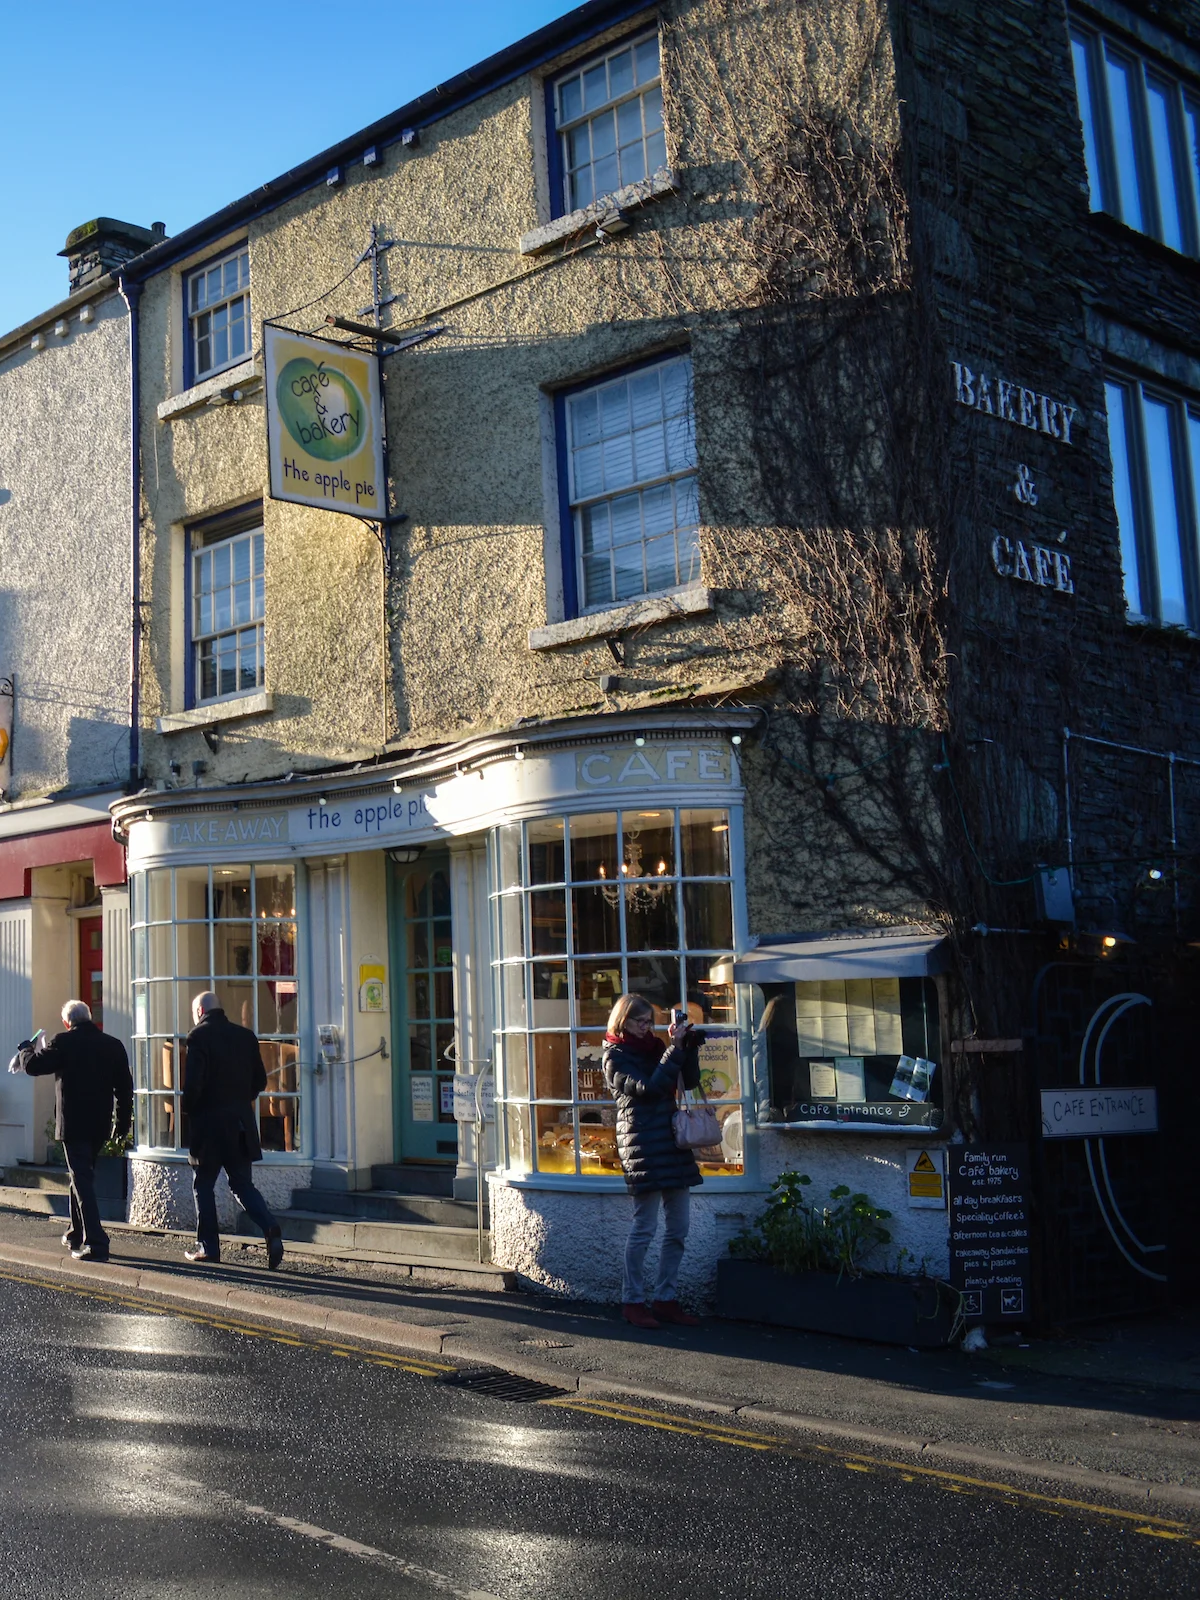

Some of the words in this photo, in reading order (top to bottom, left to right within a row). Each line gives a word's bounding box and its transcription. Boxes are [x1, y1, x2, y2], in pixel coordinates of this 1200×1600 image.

[291, 361, 330, 397] café
[313, 394, 329, 415] &
[951, 361, 1077, 445] BAKERY
[296, 410, 360, 445] bakery
[283, 457, 310, 482] the
[315, 470, 351, 498] apple
[355, 480, 375, 504] pie
[1014, 463, 1038, 506] &
[581, 750, 726, 785] CAFE
[308, 807, 341, 829] the
[354, 797, 402, 832] apple
[171, 816, 284, 843] TAKE-AWAY
[800, 1104, 830, 1115] Cafe
[836, 1104, 893, 1116] Entrance
[958, 1165, 986, 1177] Café
[988, 1165, 1019, 1180] bakery
[987, 1177, 1002, 1185] 1975
[953, 1195, 963, 1205] all
[964, 1195, 979, 1209] day
[980, 1194, 1023, 1204] breakfasts
[956, 1212, 994, 1224] Speciality
[952, 1230, 988, 1240] afternoon
[988, 1230, 1000, 1238] tea
[1007, 1229, 1028, 1237] cakes
[955, 1248, 990, 1260] takeaway
[964, 1259, 980, 1271] pies
[991, 1258, 1017, 1270] pasties
[965, 1276, 988, 1288] plenty
[988, 1276, 995, 1284] of
